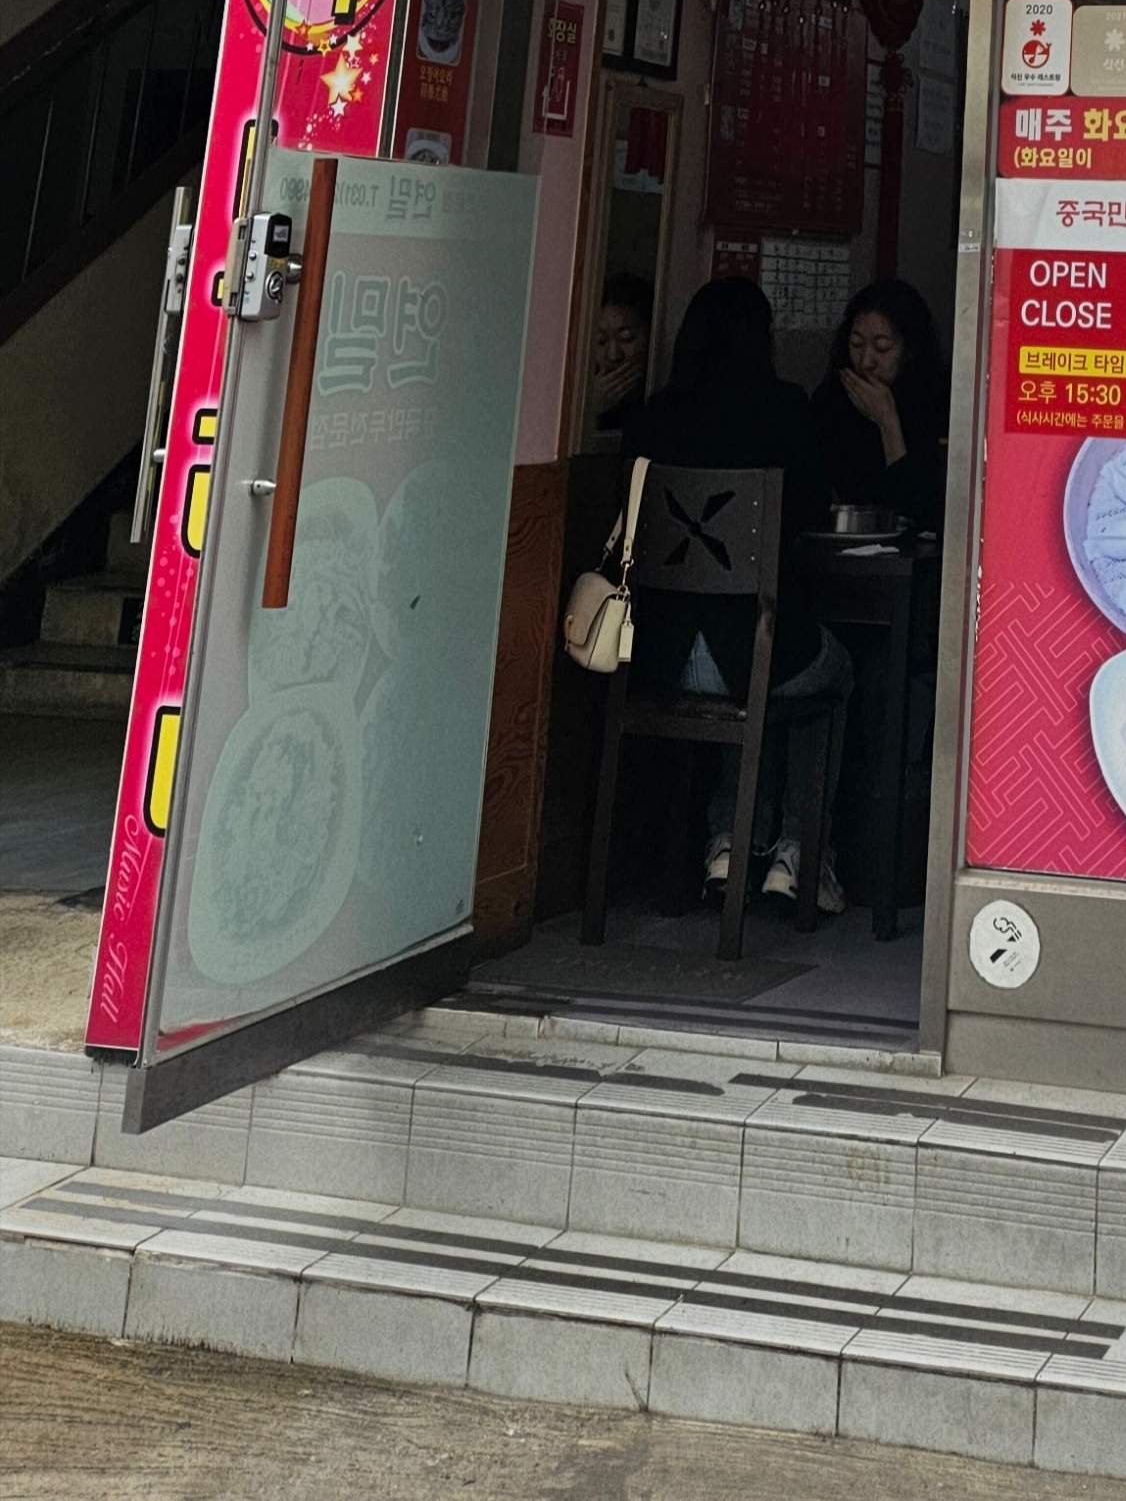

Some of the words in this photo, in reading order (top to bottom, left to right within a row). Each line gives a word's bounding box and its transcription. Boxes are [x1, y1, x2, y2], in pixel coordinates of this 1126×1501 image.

[1026, 4, 1053, 15] 2020
[1106, 12, 1126, 22] 2021
[1015, 108, 1072, 141] 매주
[1013, 146, 1092, 169] (화요일이
[1030, 260, 1107, 289] OPEN
[1021, 300, 1112, 329] CLOSE
[1025, 352, 1088, 371] 브레이크
[1094, 354, 1125, 374] 타임
[1018, 381, 1057, 404] 오후
[1065, 383, 1121, 406] 15:30
[1017, 410, 1088, 428] (식사시간에는
[1091, 413, 1125, 430] 주문을
